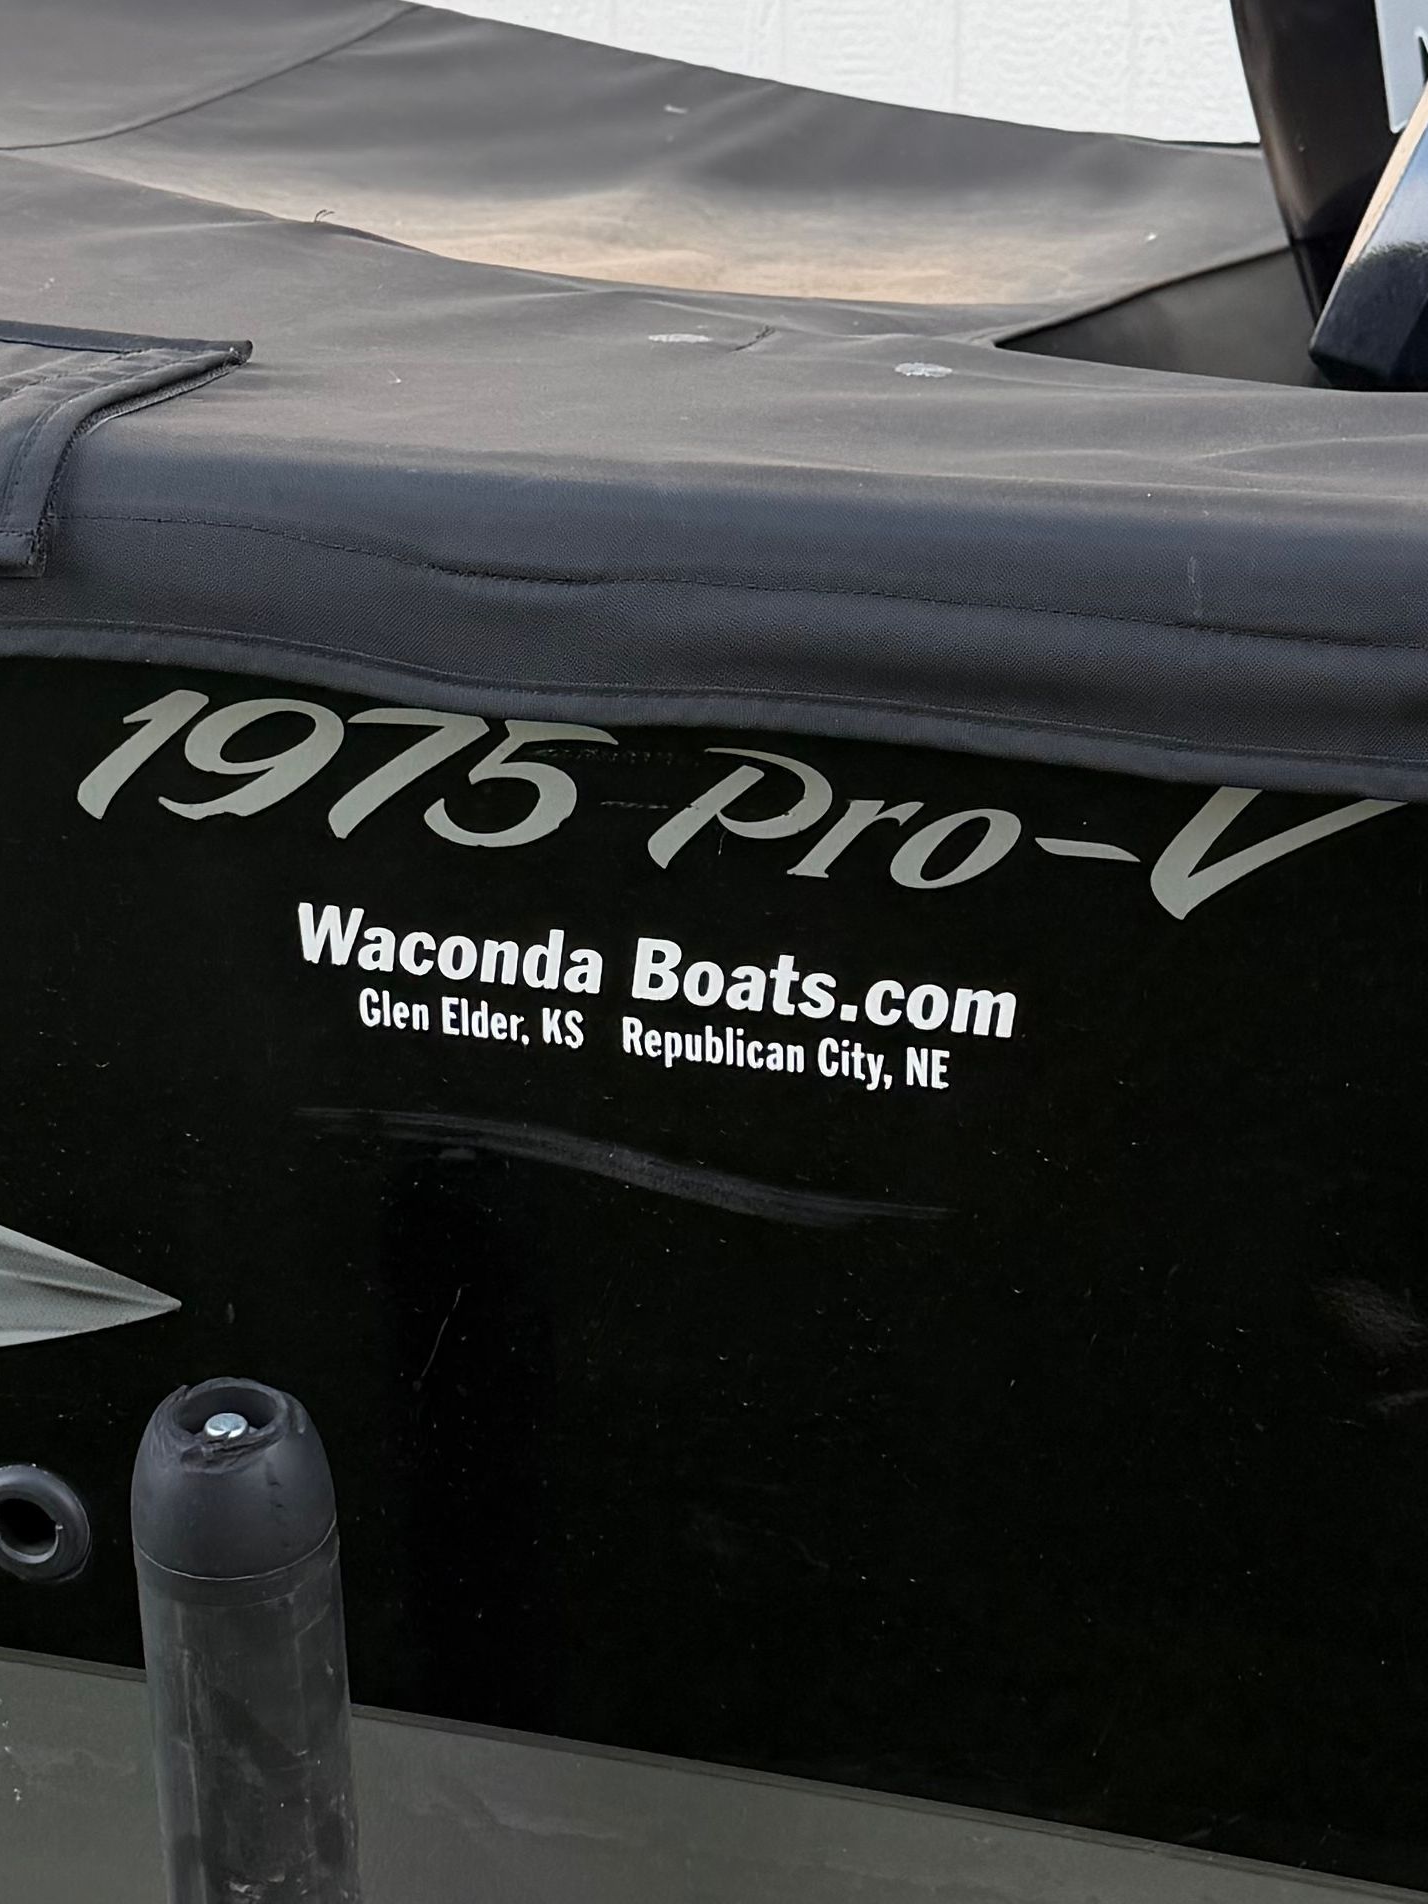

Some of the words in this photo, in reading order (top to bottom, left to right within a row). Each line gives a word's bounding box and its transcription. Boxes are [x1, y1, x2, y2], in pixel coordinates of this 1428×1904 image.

[76, 689, 619, 848] 1975
[647, 746, 1410, 921] Pro-V
[297, 901, 604, 995] Waconda
[630, 936, 1018, 1039] Boats.com
[358, 987, 430, 1032] Glen
[441, 995, 530, 1047] Elder,
[541, 1006, 585, 1050] KS
[621, 1015, 806, 1069] Republican
[816, 1037, 893, 1091] City,
[905, 1046, 951, 1090] NE
